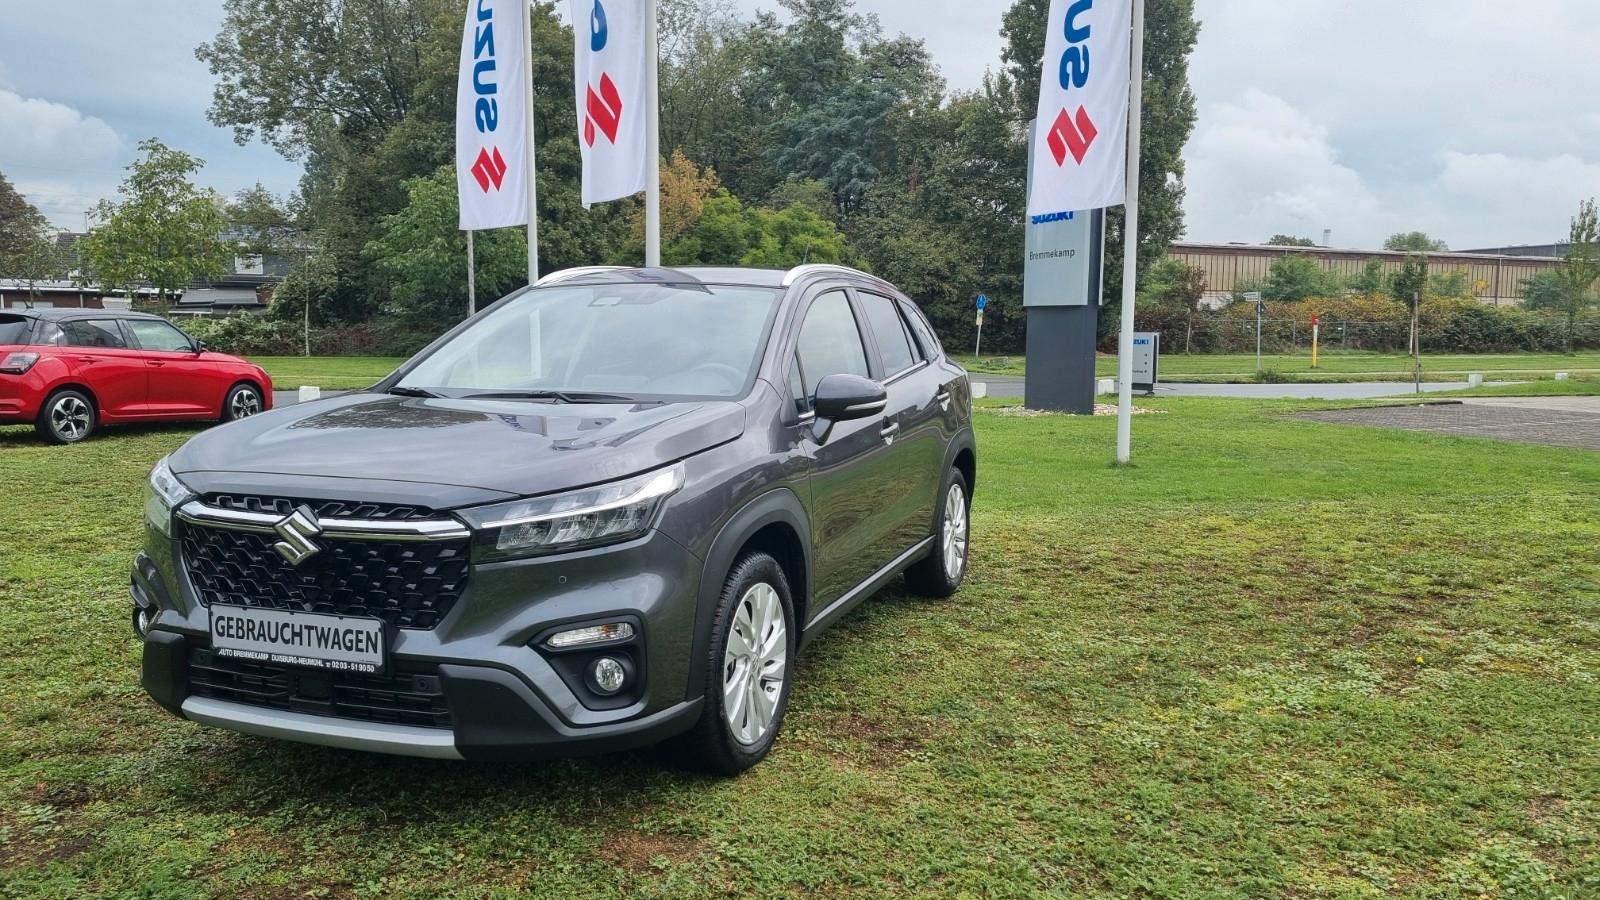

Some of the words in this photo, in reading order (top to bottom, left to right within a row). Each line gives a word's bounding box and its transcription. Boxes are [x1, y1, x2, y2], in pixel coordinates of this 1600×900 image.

[1029, 249, 1075, 260] Bremmekamp
[214, 615, 378, 654] GEBRAUCHTWAGEN
[218, 648, 233, 656] AUTO
[233, 650, 269, 660] BREMMEKAMP
